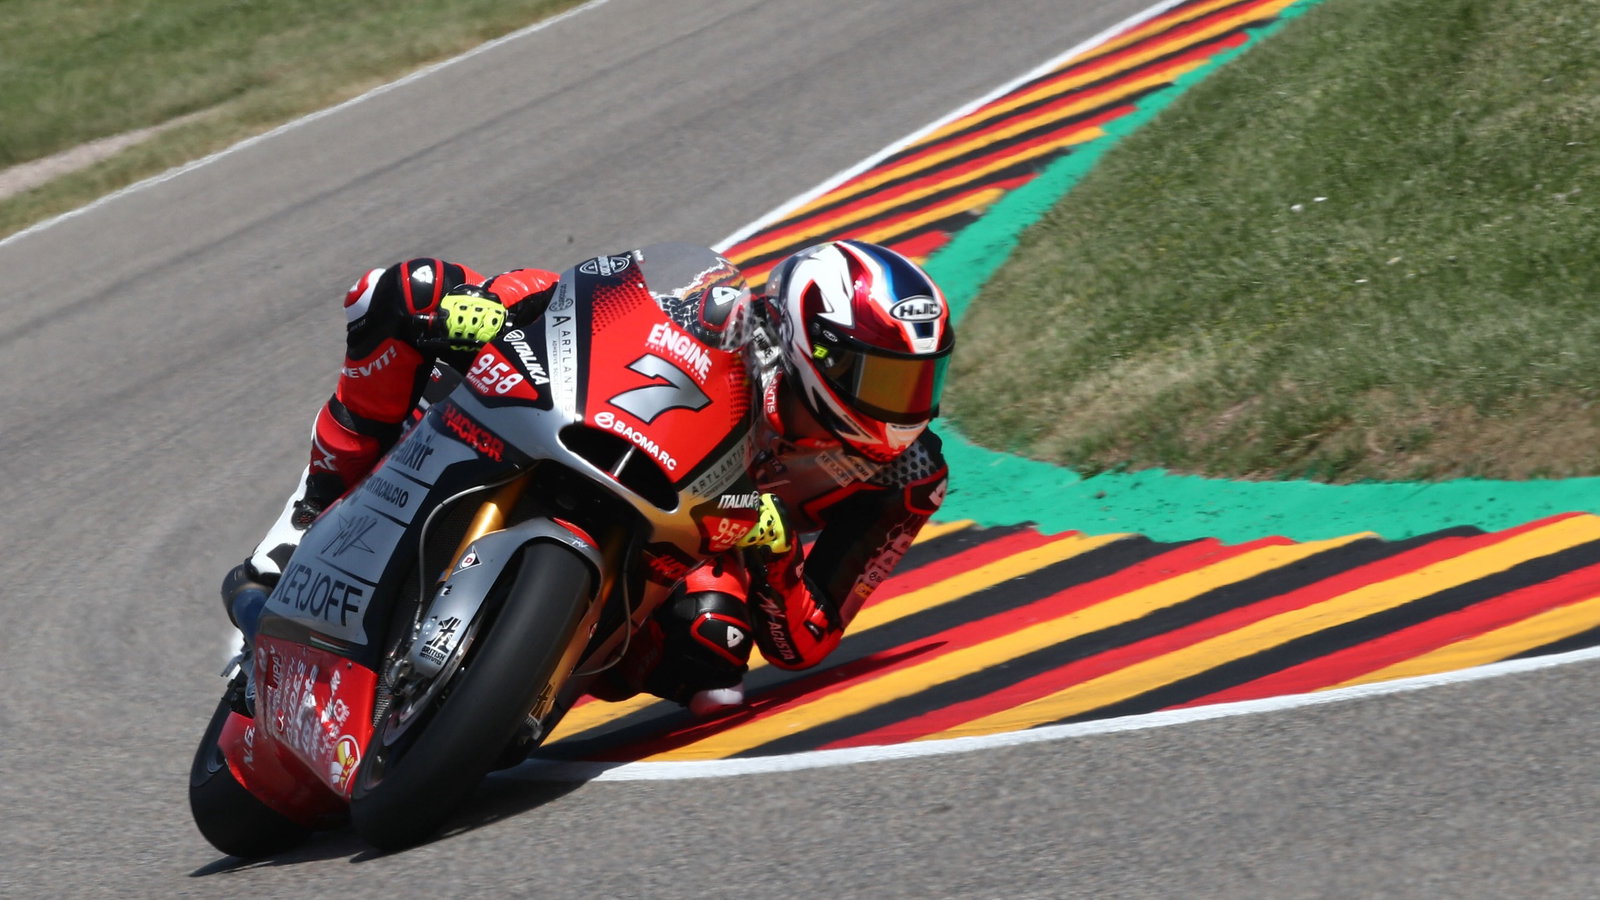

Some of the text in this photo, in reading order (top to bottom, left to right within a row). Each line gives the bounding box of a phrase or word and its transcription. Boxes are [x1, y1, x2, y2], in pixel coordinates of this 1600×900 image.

[899, 303, 938, 317] HJC
[511, 341, 550, 385] ITALIKA
[561, 330, 575, 412] ARTLANTIS
[606, 352, 713, 425] 7
[717, 494, 755, 509] ITALIKA
[421, 645, 447, 662] BRITISH
[767, 621, 797, 660] AGUSTA
